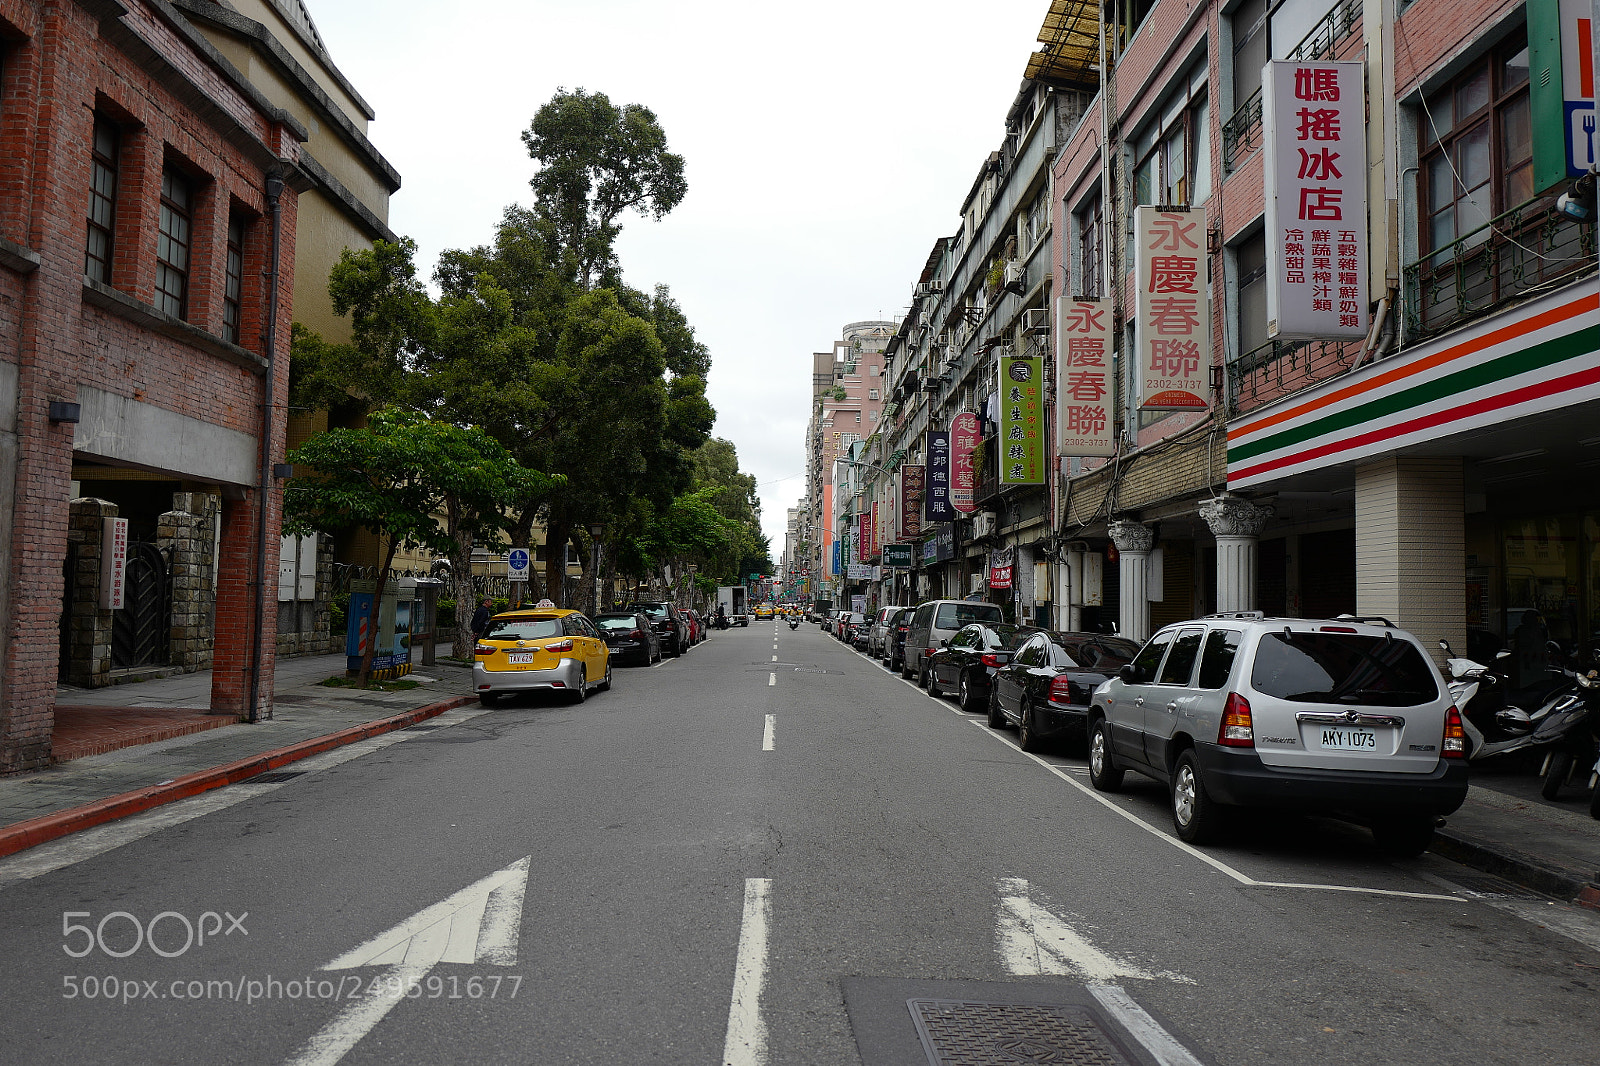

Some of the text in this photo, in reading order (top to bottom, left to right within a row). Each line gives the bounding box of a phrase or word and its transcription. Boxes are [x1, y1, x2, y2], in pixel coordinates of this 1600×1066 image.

[1294, 67, 1343, 221] 媽搖冰店
[1148, 212, 1200, 378] 永慶春聯
[1284, 228, 1305, 284] 冷熱甜品
[1310, 229, 1333, 312] 鮮蔬果榨汁類
[1337, 230, 1359, 328] 五穀雜糧鮮奶類
[1066, 302, 1107, 435] 永慶春聯
[1146, 379, 1202, 390] 2302-3737
[1064, 438, 1109, 447] 2302-3737
[932, 456, 947, 513] 邦德西服
